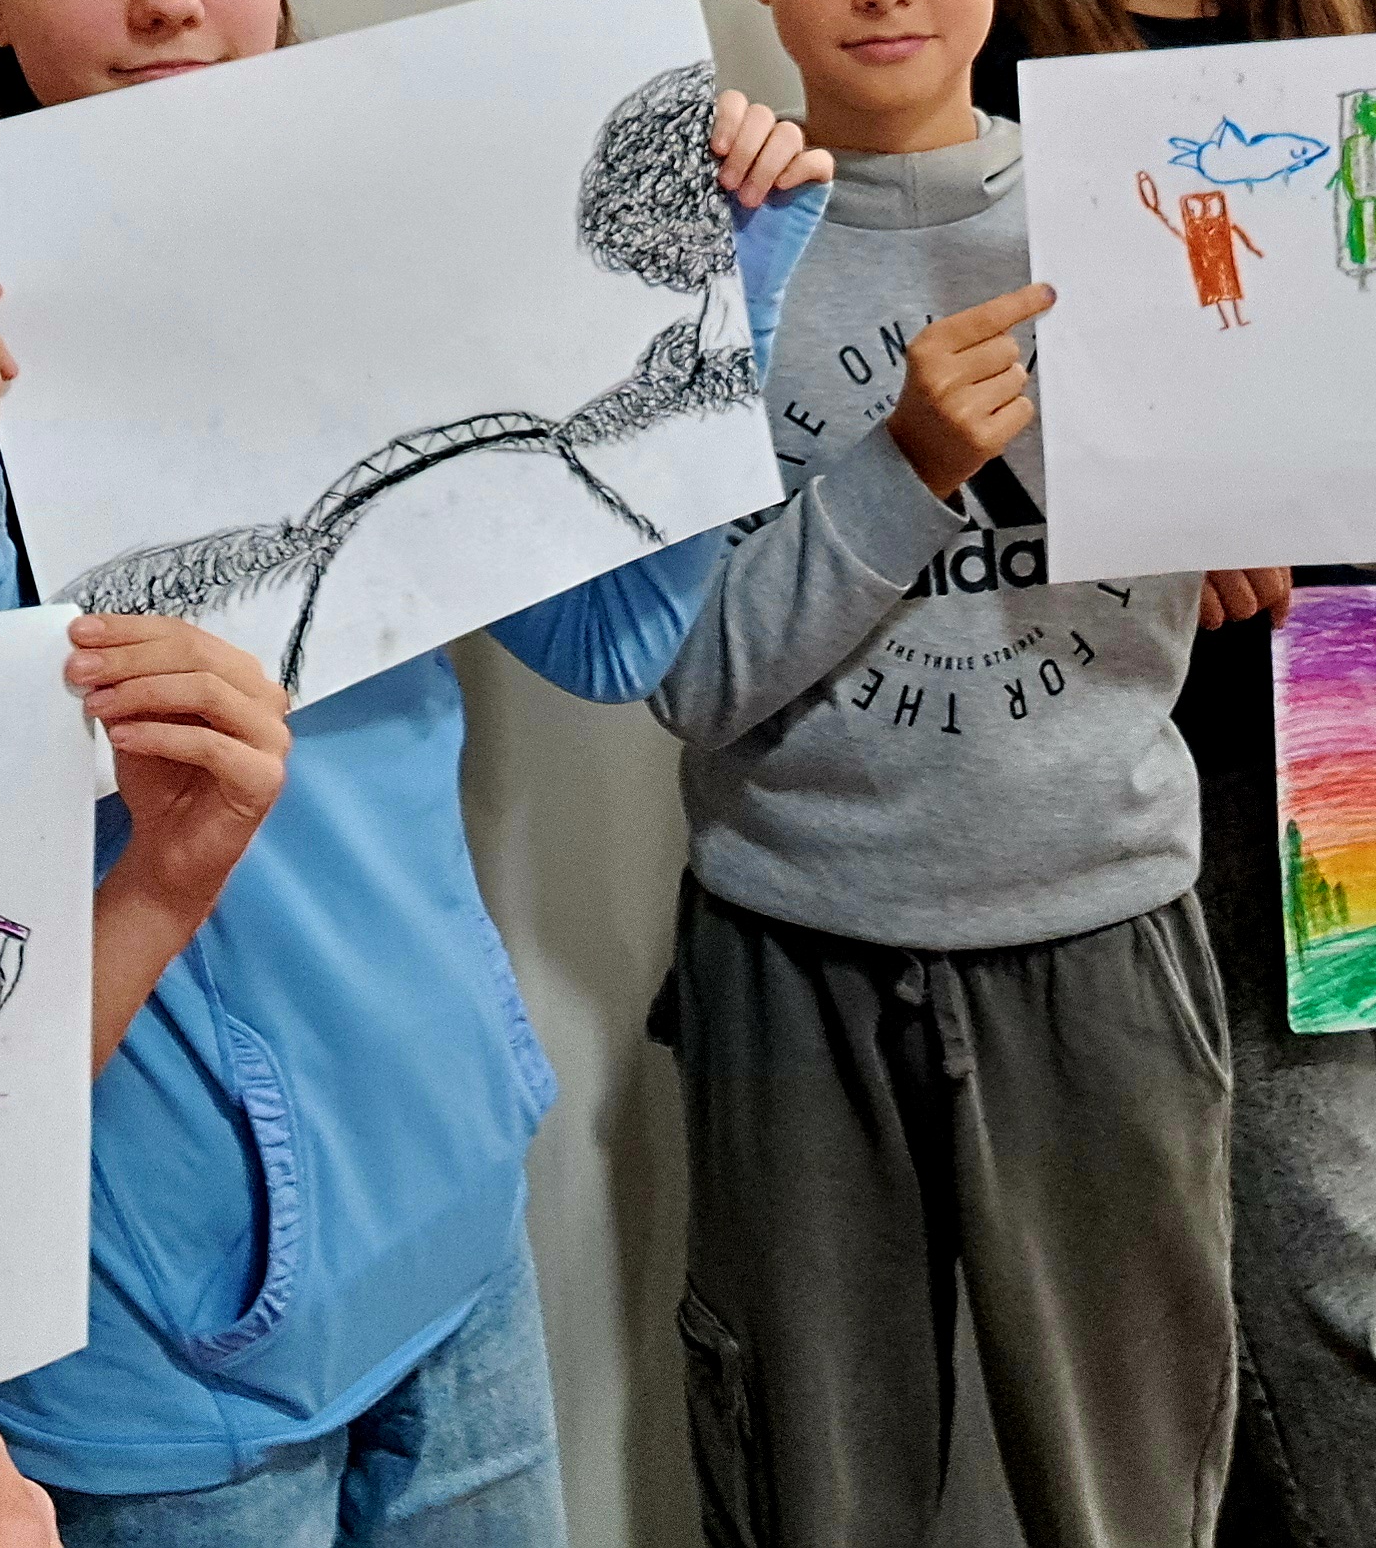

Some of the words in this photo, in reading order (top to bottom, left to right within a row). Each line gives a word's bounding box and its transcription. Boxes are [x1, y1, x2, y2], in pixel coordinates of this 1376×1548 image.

[886, 639, 914, 662] THE
[924, 653, 975, 671] THREE
[1004, 630, 1095, 720] FOR
[851, 668, 962, 735] THE
